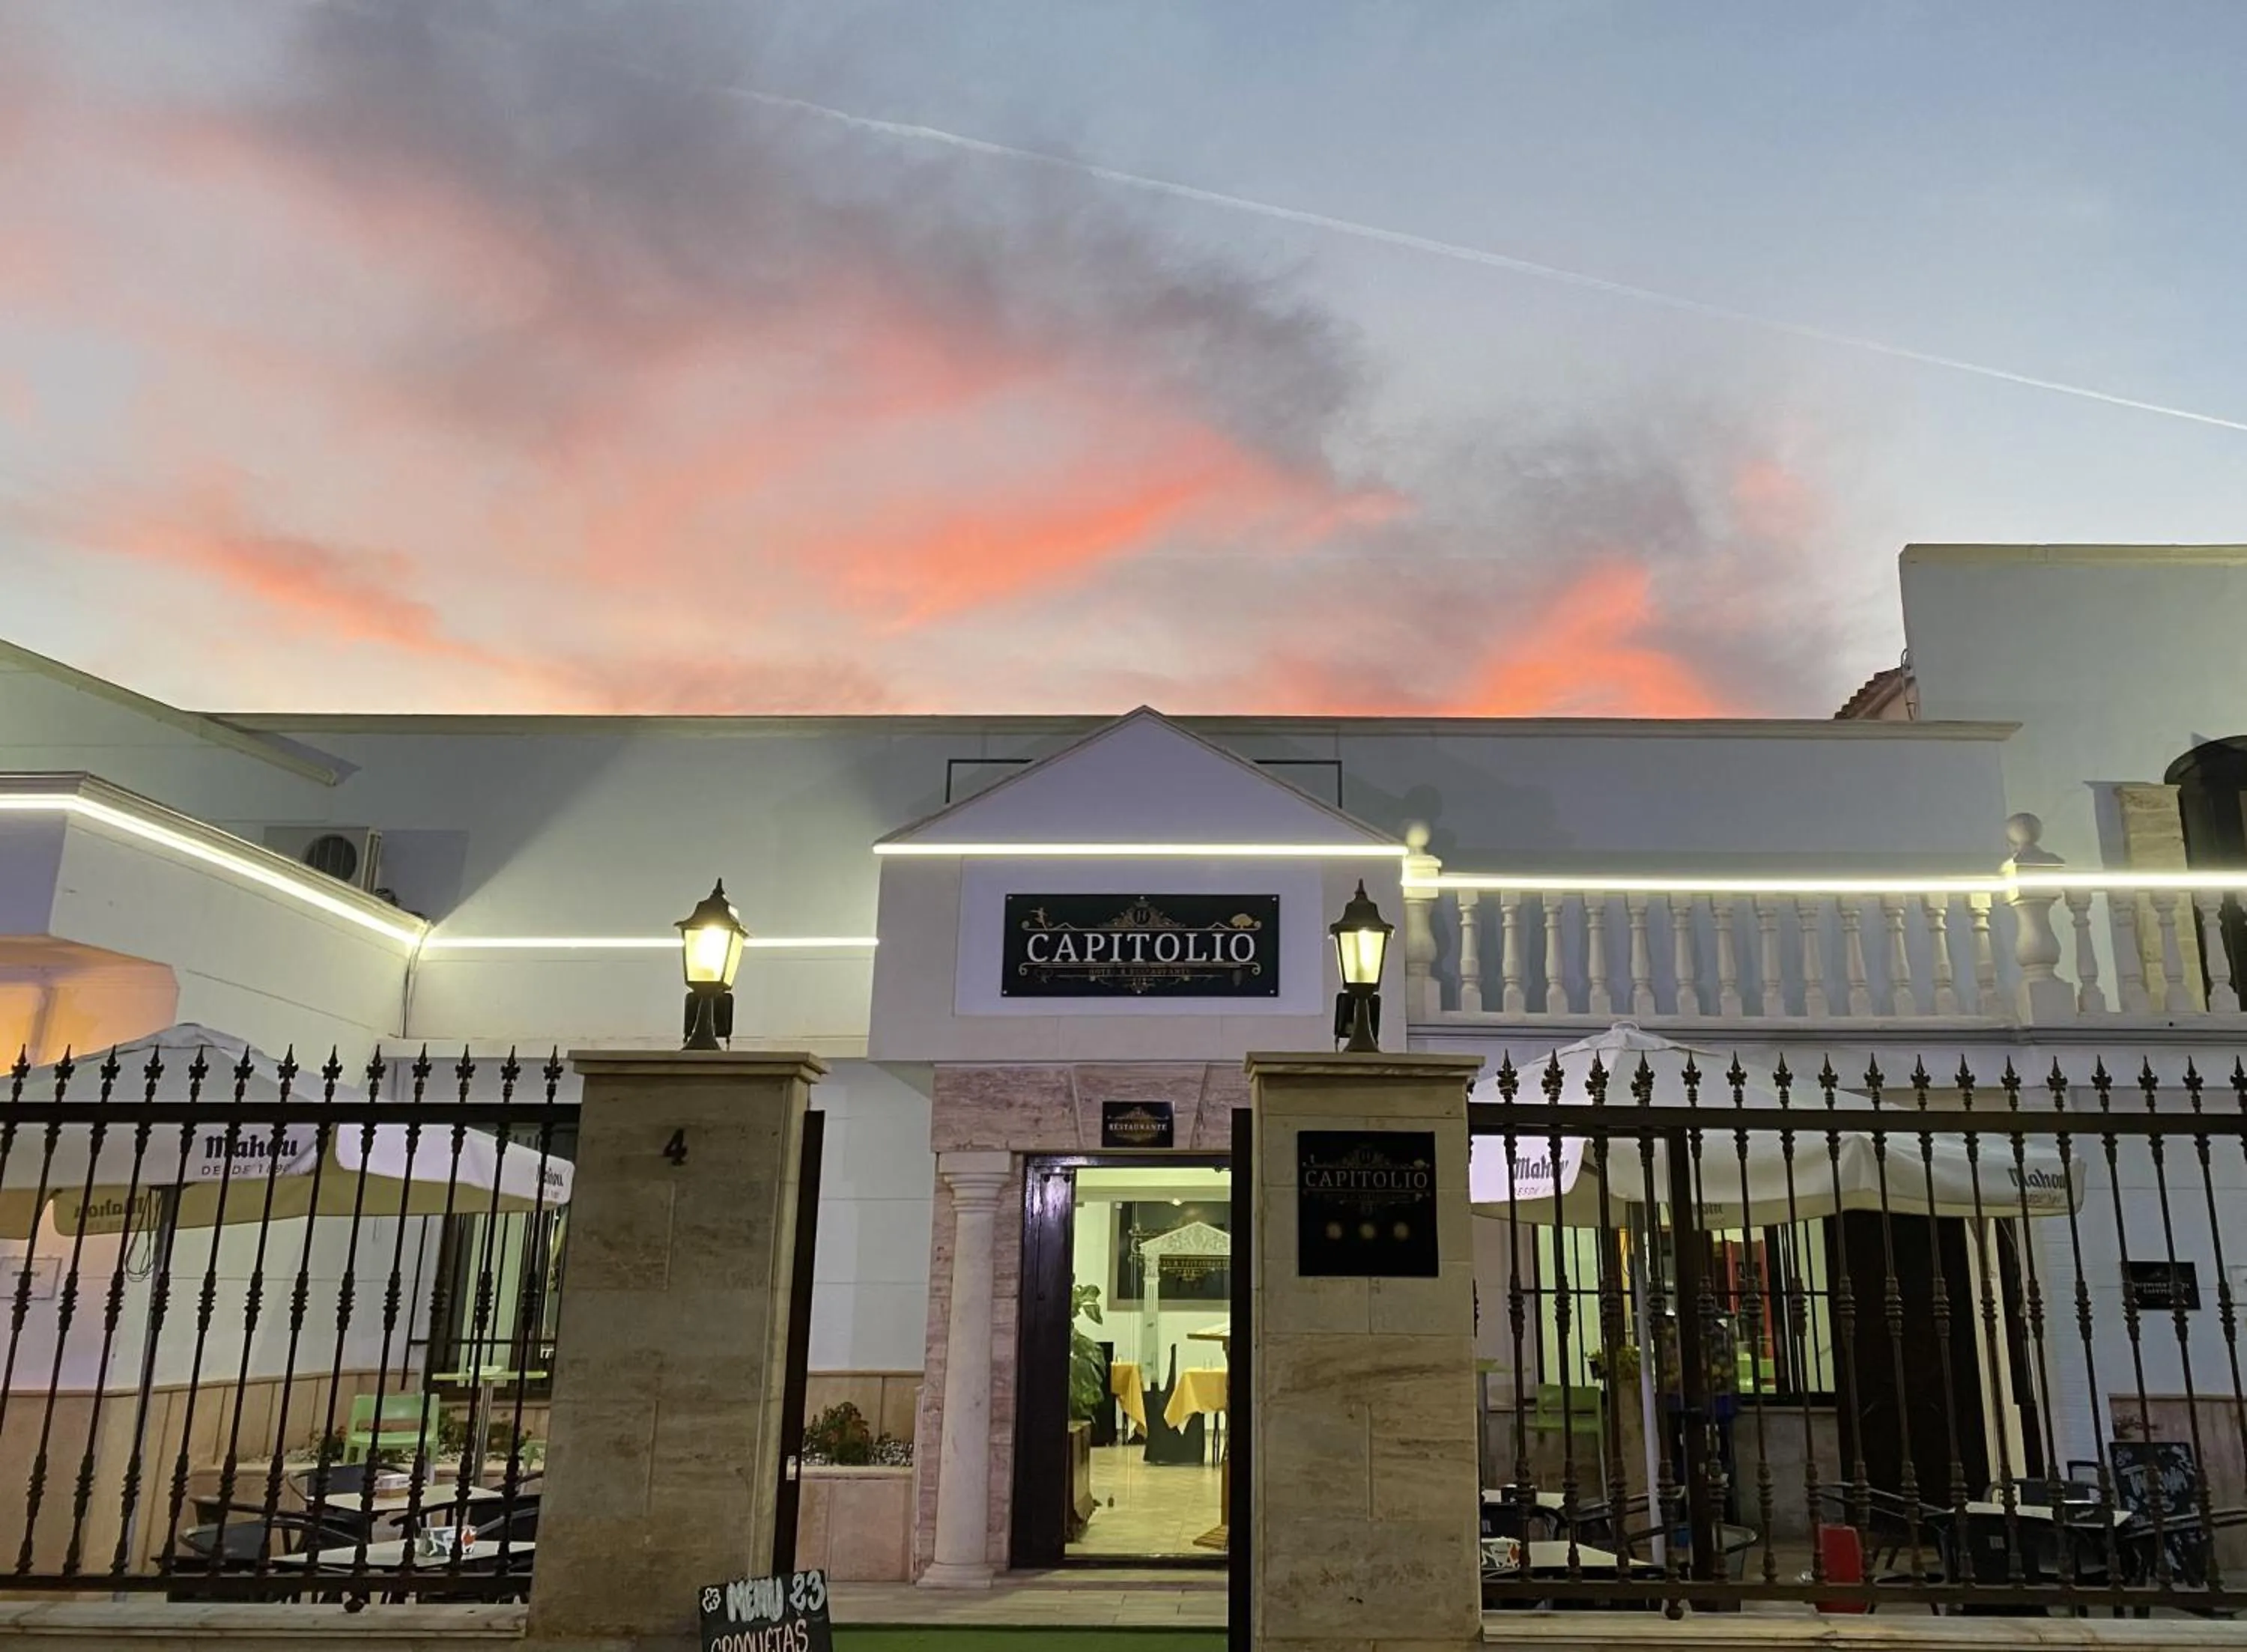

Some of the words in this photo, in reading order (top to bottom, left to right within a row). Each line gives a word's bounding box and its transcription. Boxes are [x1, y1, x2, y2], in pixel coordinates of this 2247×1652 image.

[1027, 933, 1255, 962] CAPITOLIO
[663, 1128, 688, 1166] 4
[201, 1164, 251, 1176] DEDE
[1306, 1170, 1428, 1188] CAPITOLIO
[1514, 1154, 1570, 1180] Mahu
[789, 1570, 825, 1611] 23
